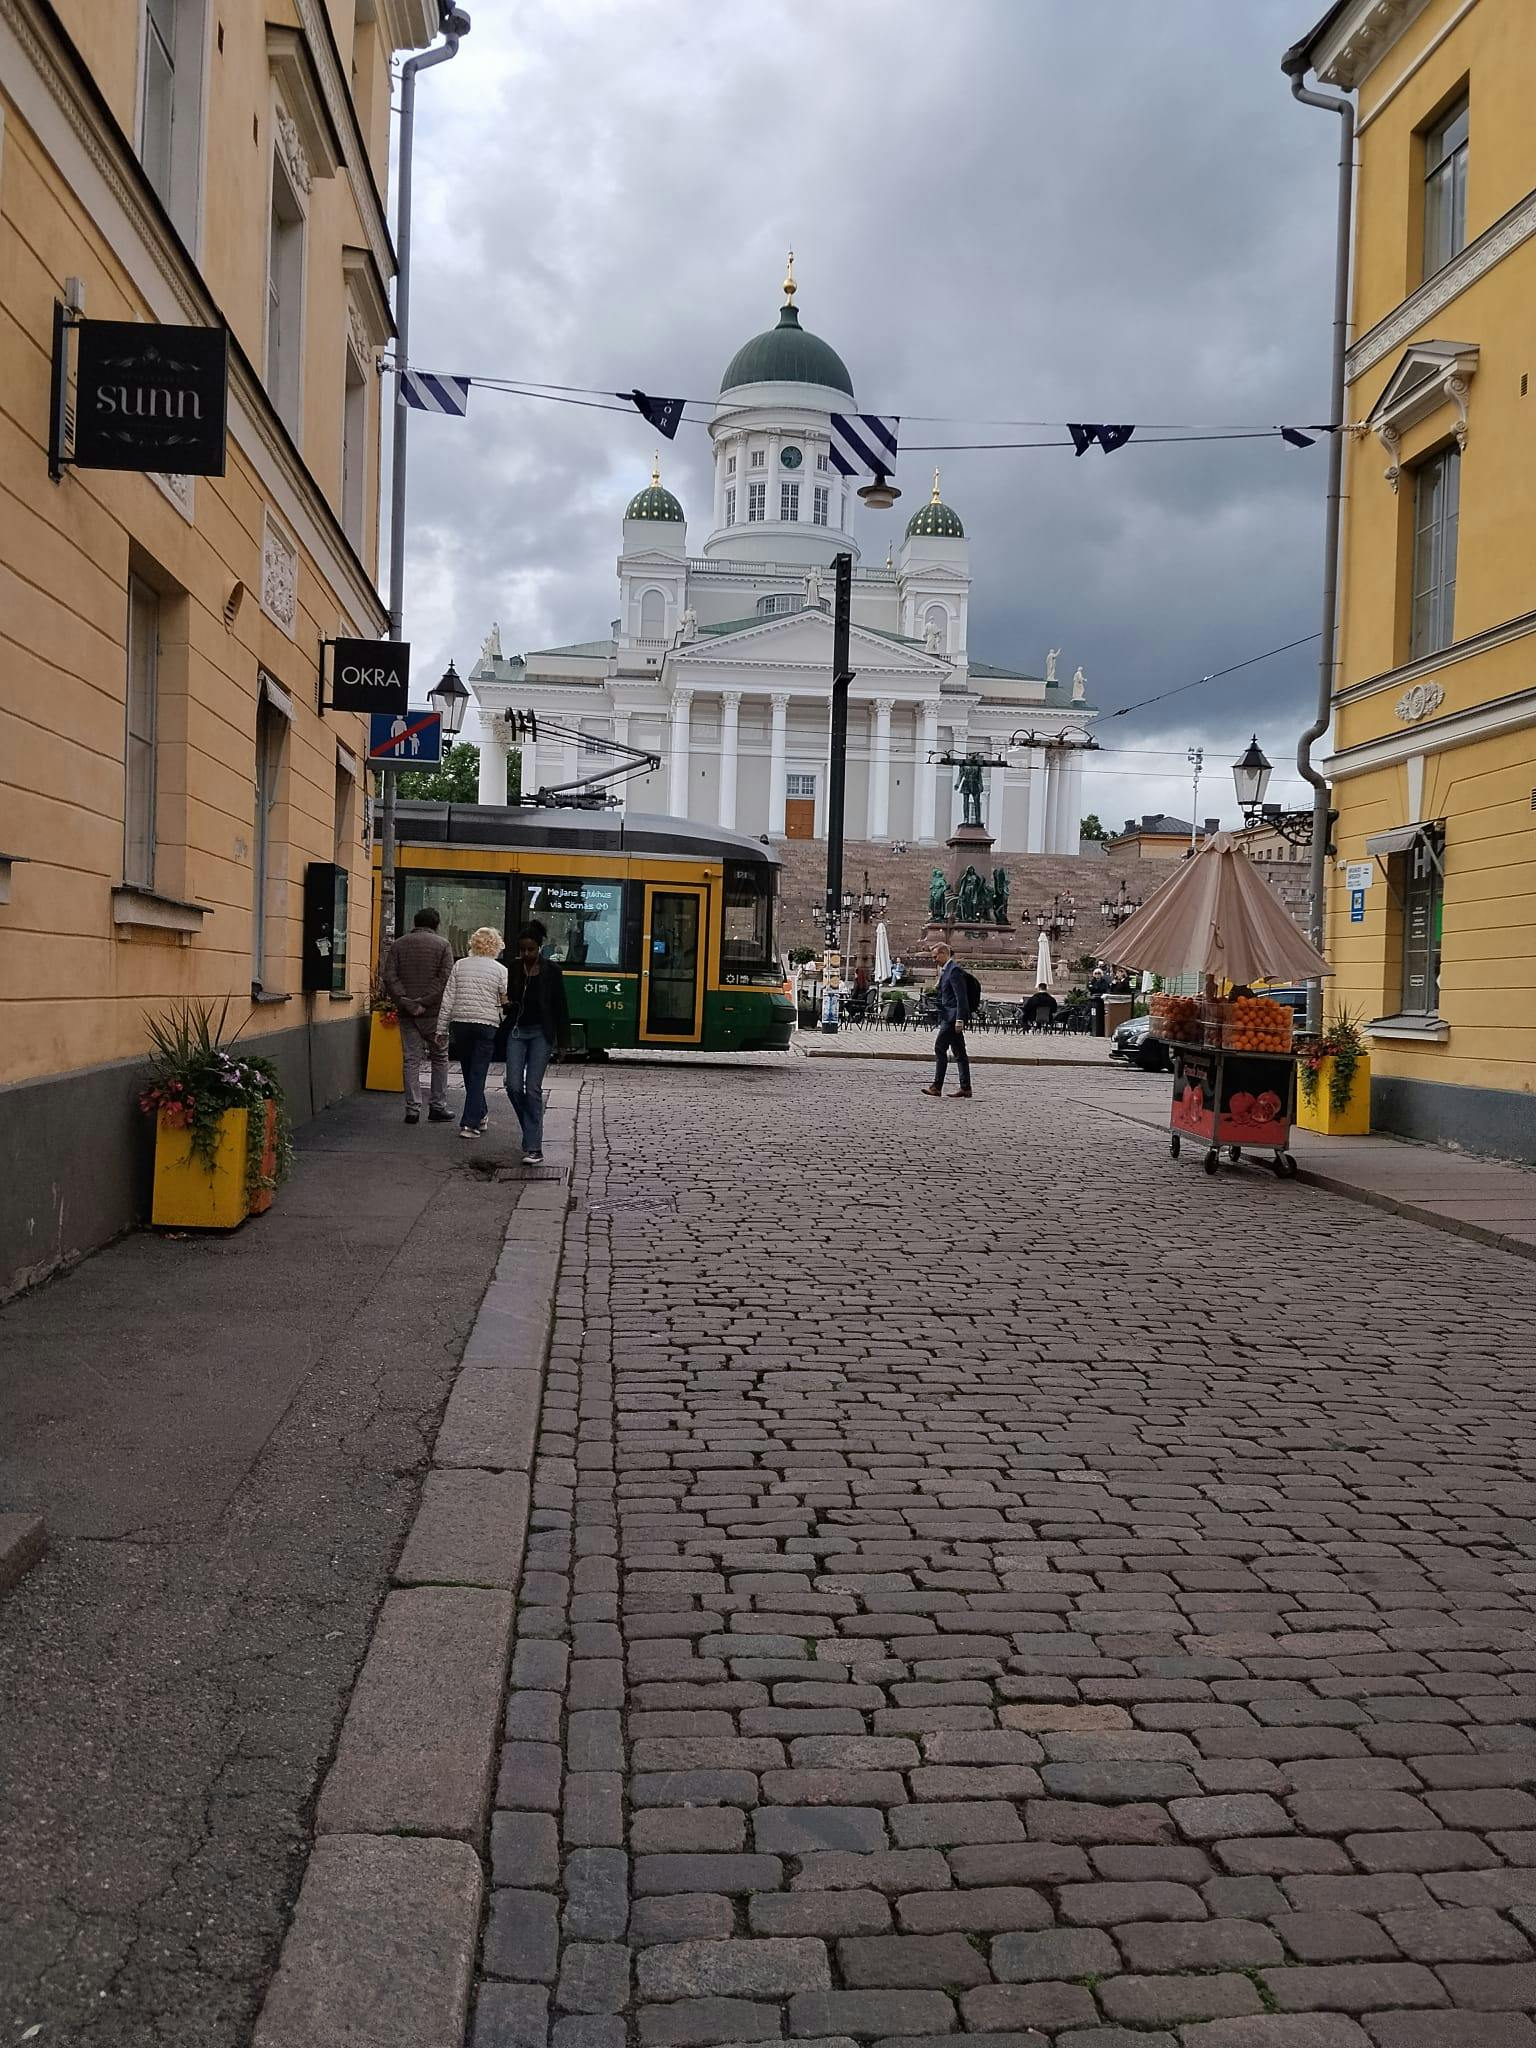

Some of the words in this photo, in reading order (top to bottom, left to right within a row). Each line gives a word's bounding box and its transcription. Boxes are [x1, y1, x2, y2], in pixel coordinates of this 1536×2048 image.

[96, 385, 204, 419] sunn
[341, 666, 401, 687] OKRA
[528, 886, 542, 909] 7
[550, 900, 562, 909] via
[605, 1000, 624, 1010] 415
